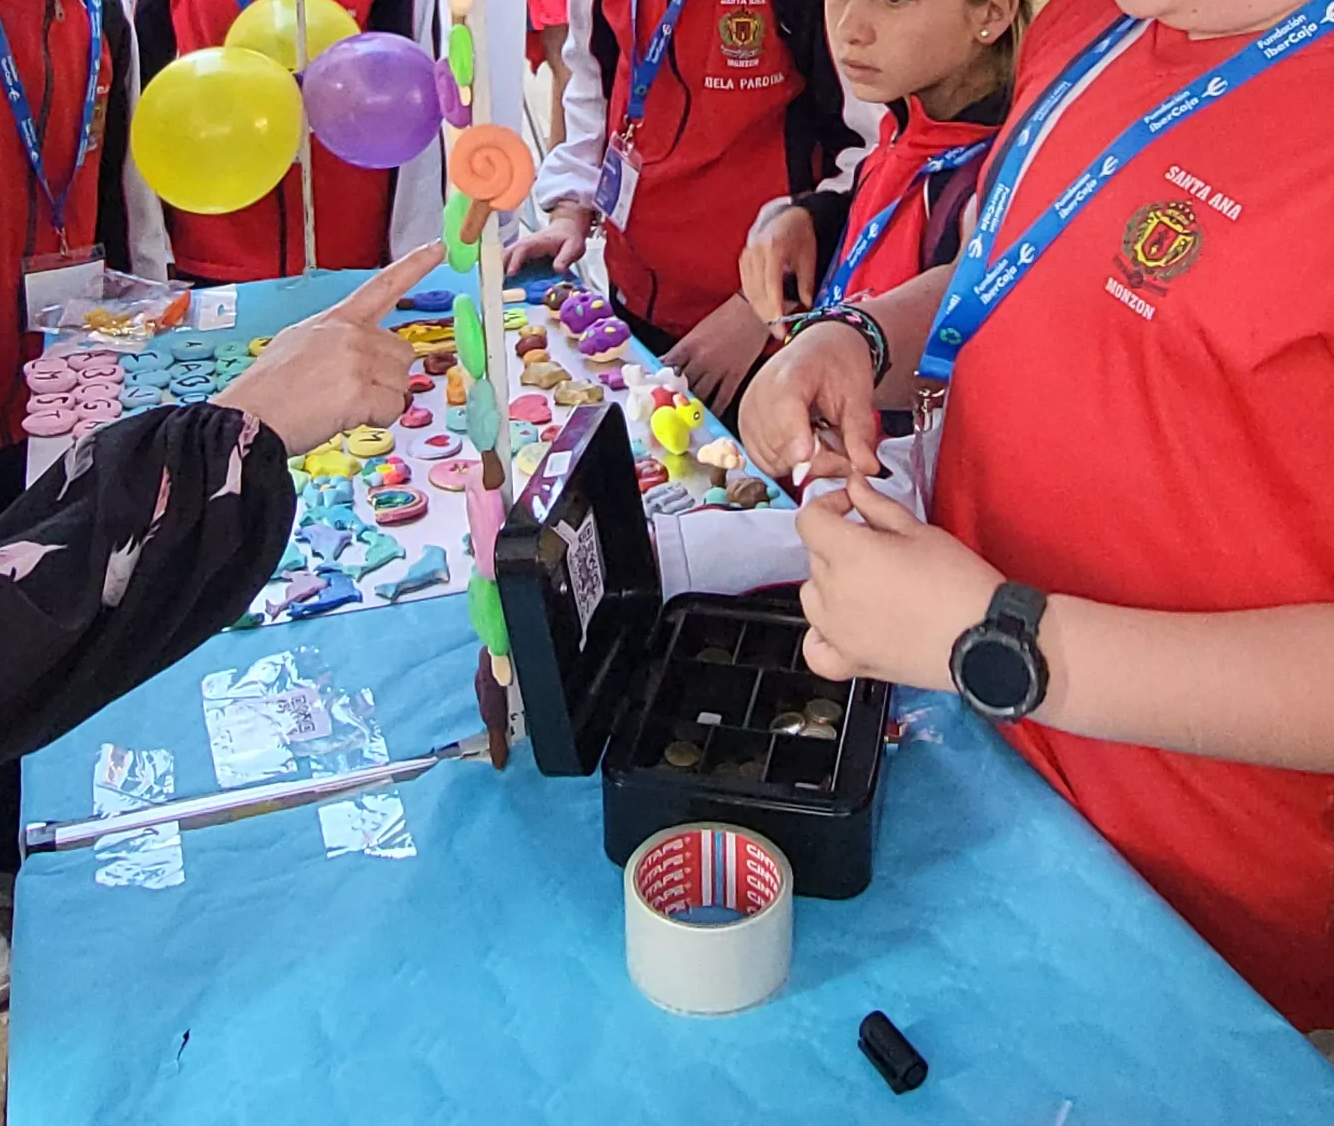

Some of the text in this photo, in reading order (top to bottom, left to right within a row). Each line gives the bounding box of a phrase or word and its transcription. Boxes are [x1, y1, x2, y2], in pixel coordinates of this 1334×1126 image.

[1257, 13, 1307, 51] Fundación
[1143, 90, 1192, 125] Fundación
[1164, 164, 1243, 222] SANTA ANA
[1105, 277, 1156, 321] MONZON
